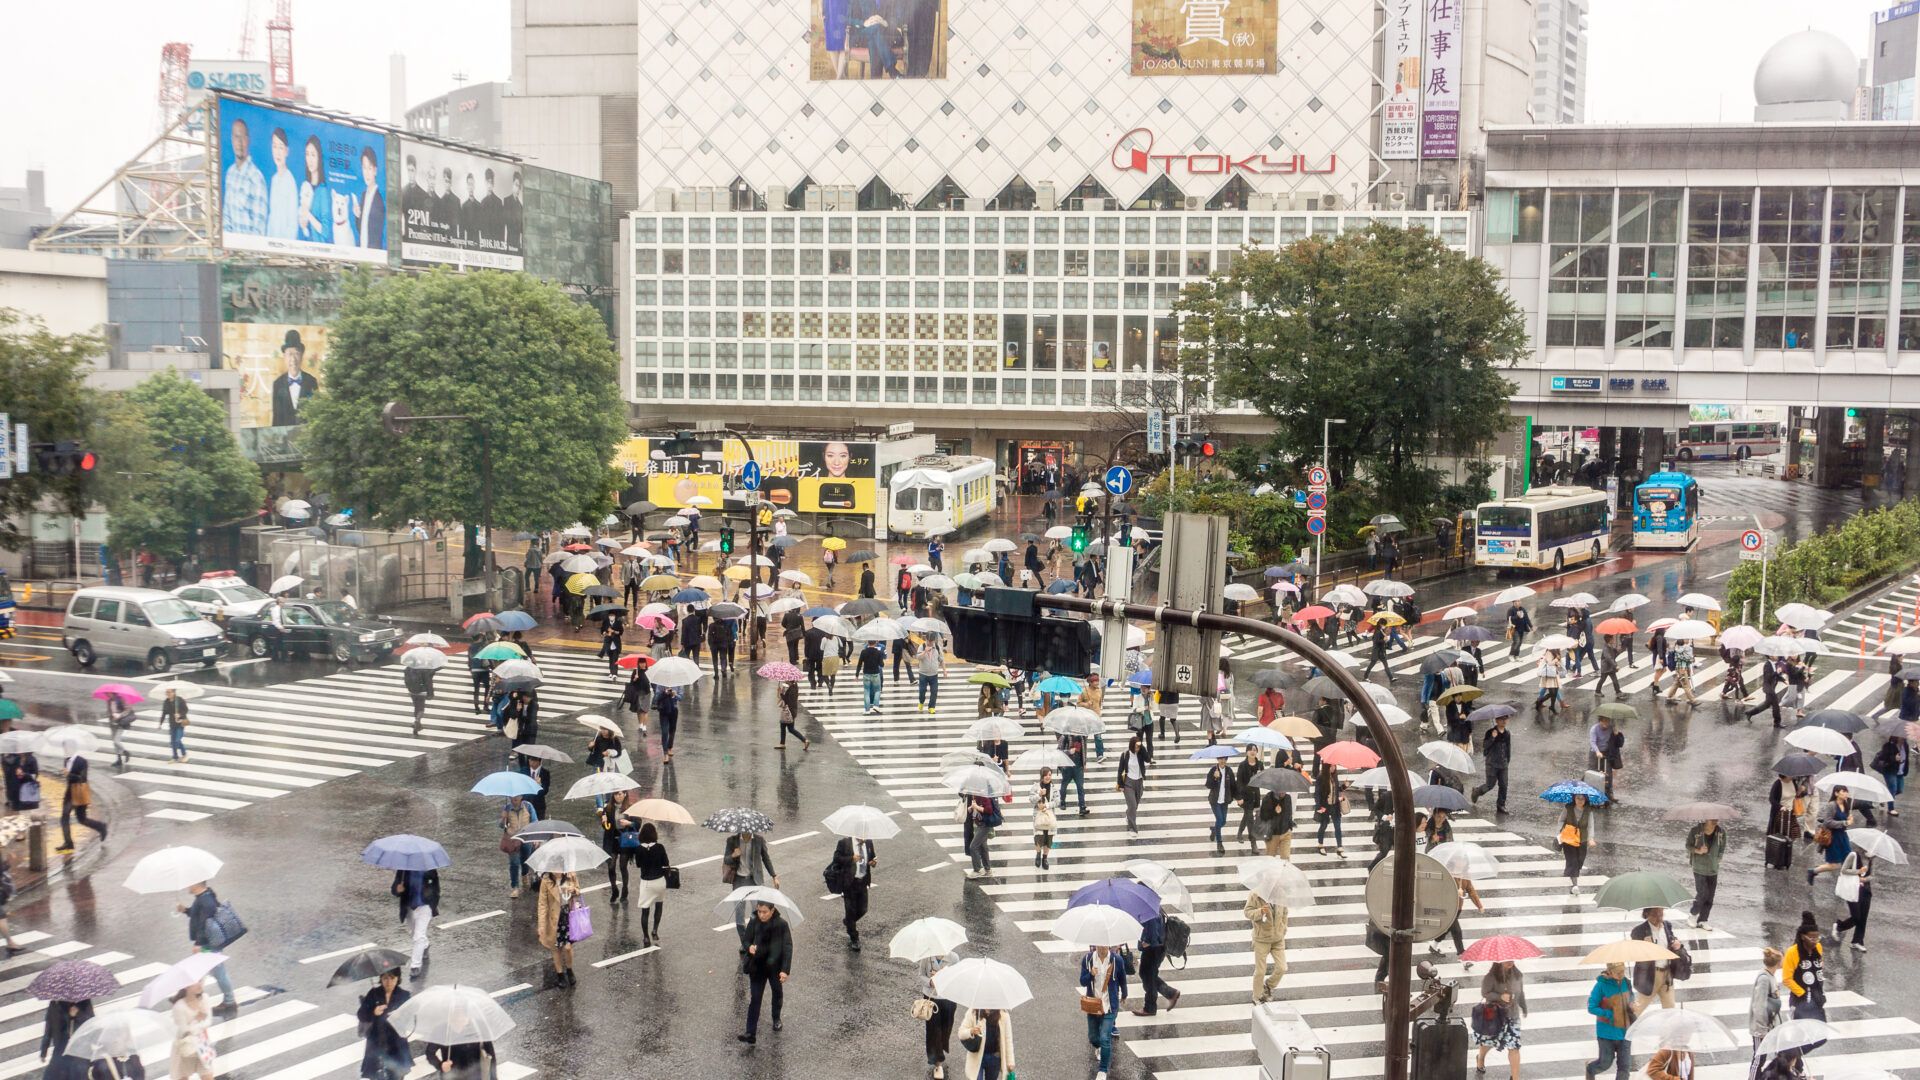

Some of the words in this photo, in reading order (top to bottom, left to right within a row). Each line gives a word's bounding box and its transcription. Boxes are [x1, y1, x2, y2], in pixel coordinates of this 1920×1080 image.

[1178, 0, 1231, 47] 賞
[1427, 0, 1453, 96] 仕事展
[1150, 154, 1336, 175] TOKYU
[407, 208, 430, 227] 2PM
[230, 280, 261, 309] JR
[243, 353, 273, 396] 天
[1153, 411, 1161, 449] 渋谷駅前
[623, 459, 823, 482] 新発明！エリアァンディ
[1513, 478, 1523, 498] Are
